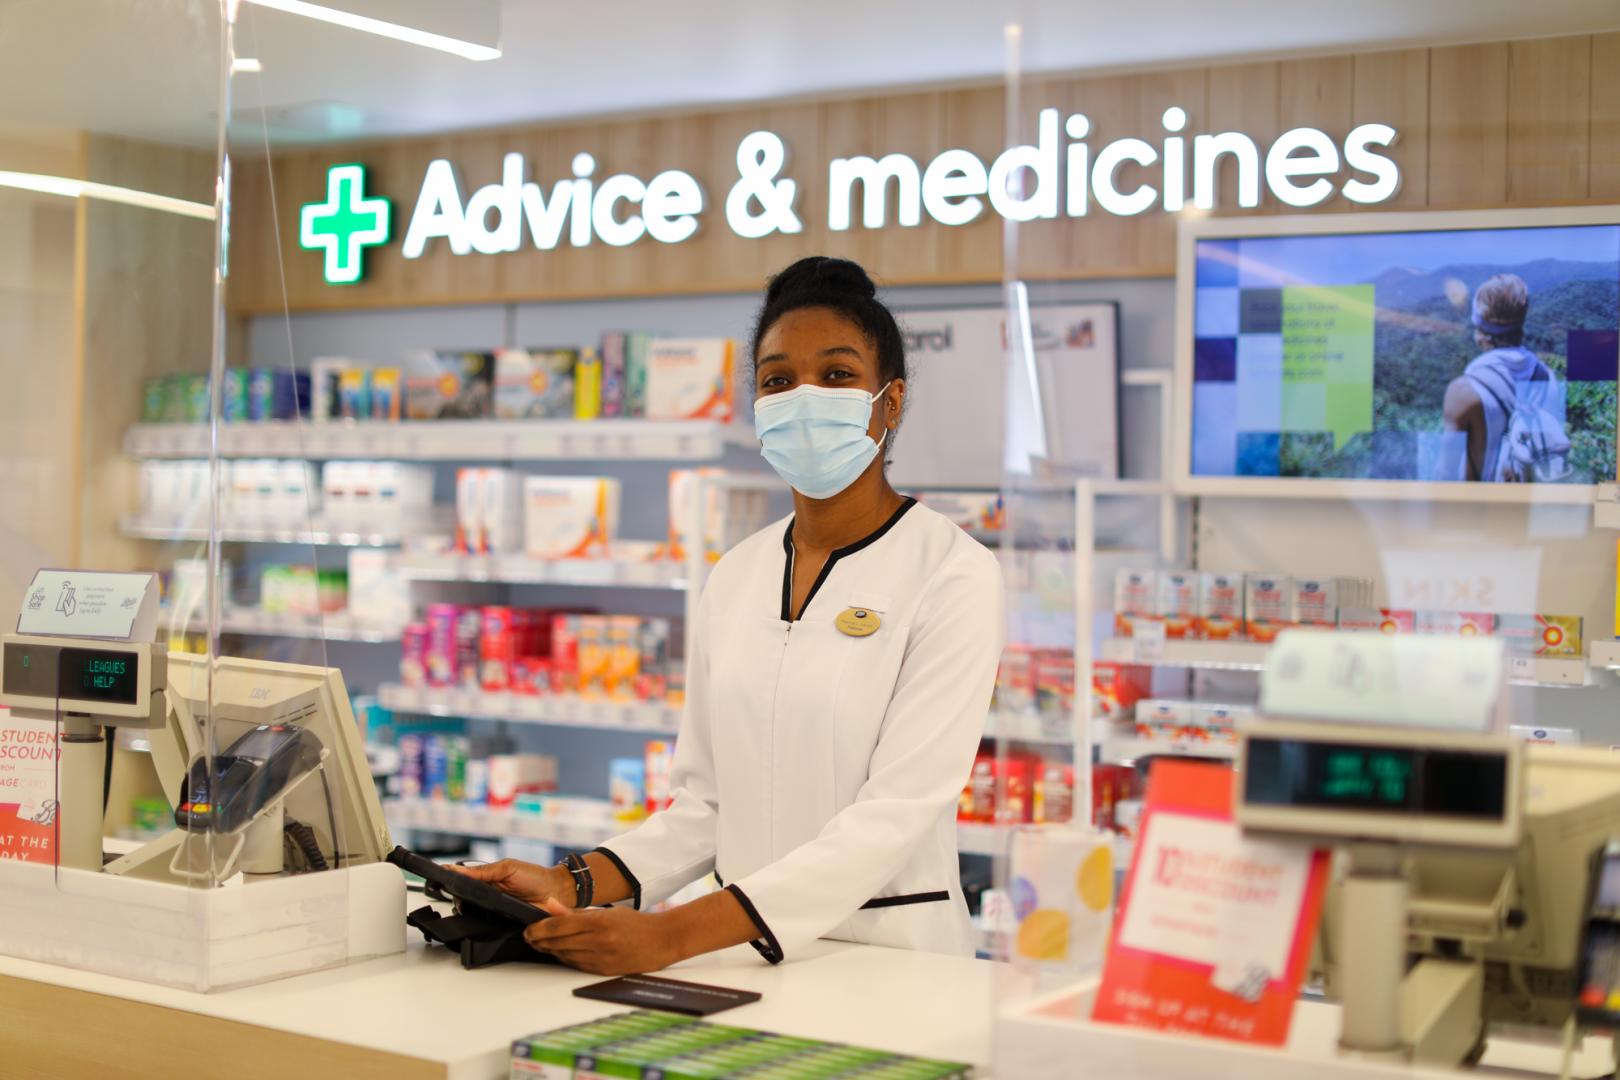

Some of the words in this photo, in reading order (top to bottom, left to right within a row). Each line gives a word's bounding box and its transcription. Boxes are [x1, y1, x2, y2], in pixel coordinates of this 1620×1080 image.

[402, 152, 703, 258] Advice
[725, 131, 802, 238] &
[828, 106, 1399, 231] medicines
[89, 660, 126, 674] LEAGUES
[93, 676, 115, 688] HELP
[21, 835, 49, 849] THE
